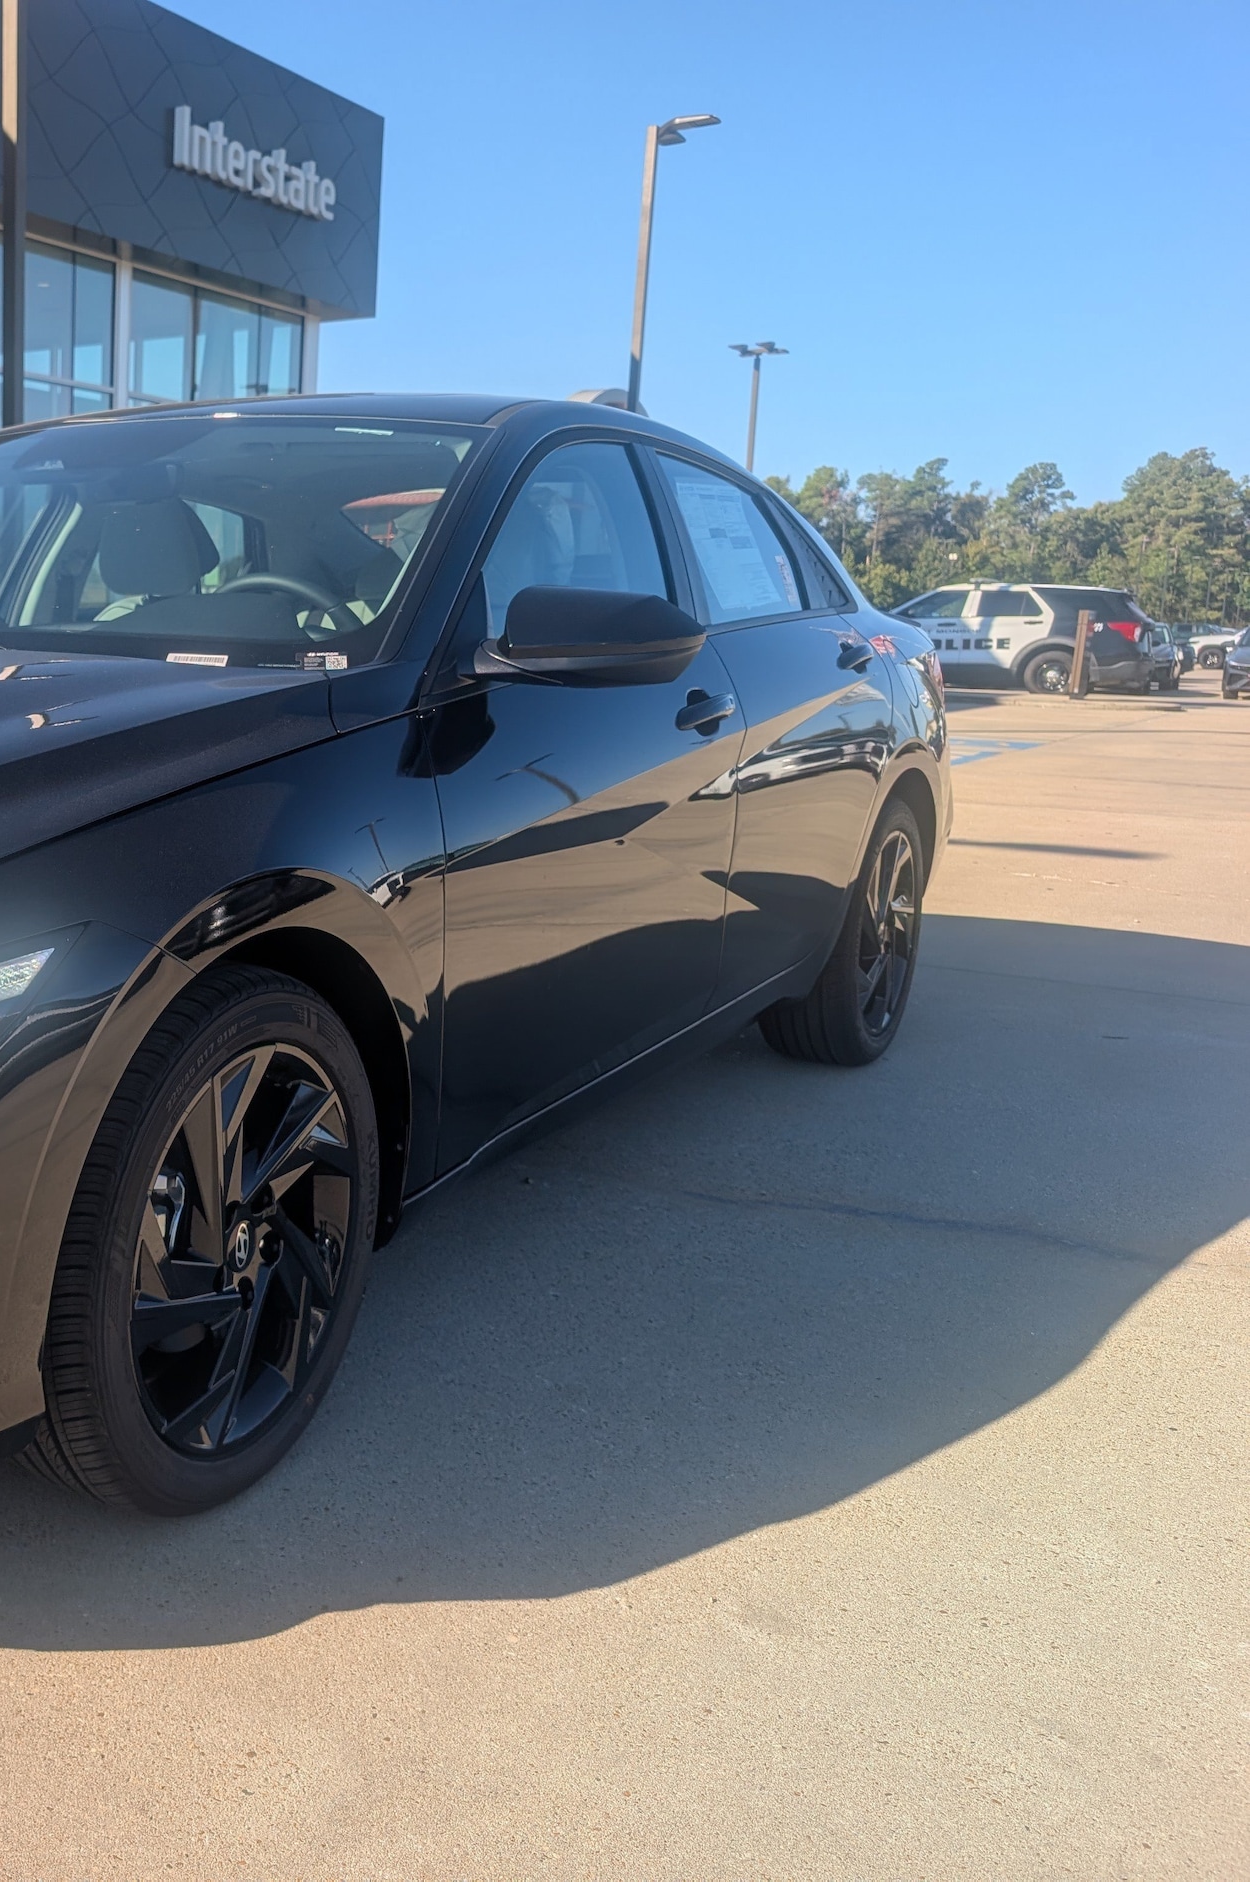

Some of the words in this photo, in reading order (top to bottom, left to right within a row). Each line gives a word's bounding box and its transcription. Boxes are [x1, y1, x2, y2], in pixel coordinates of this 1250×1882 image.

[172, 105, 337, 221] Interstate
[196, 1042, 215, 1068] R17
[216, 1023, 239, 1046] 91W
